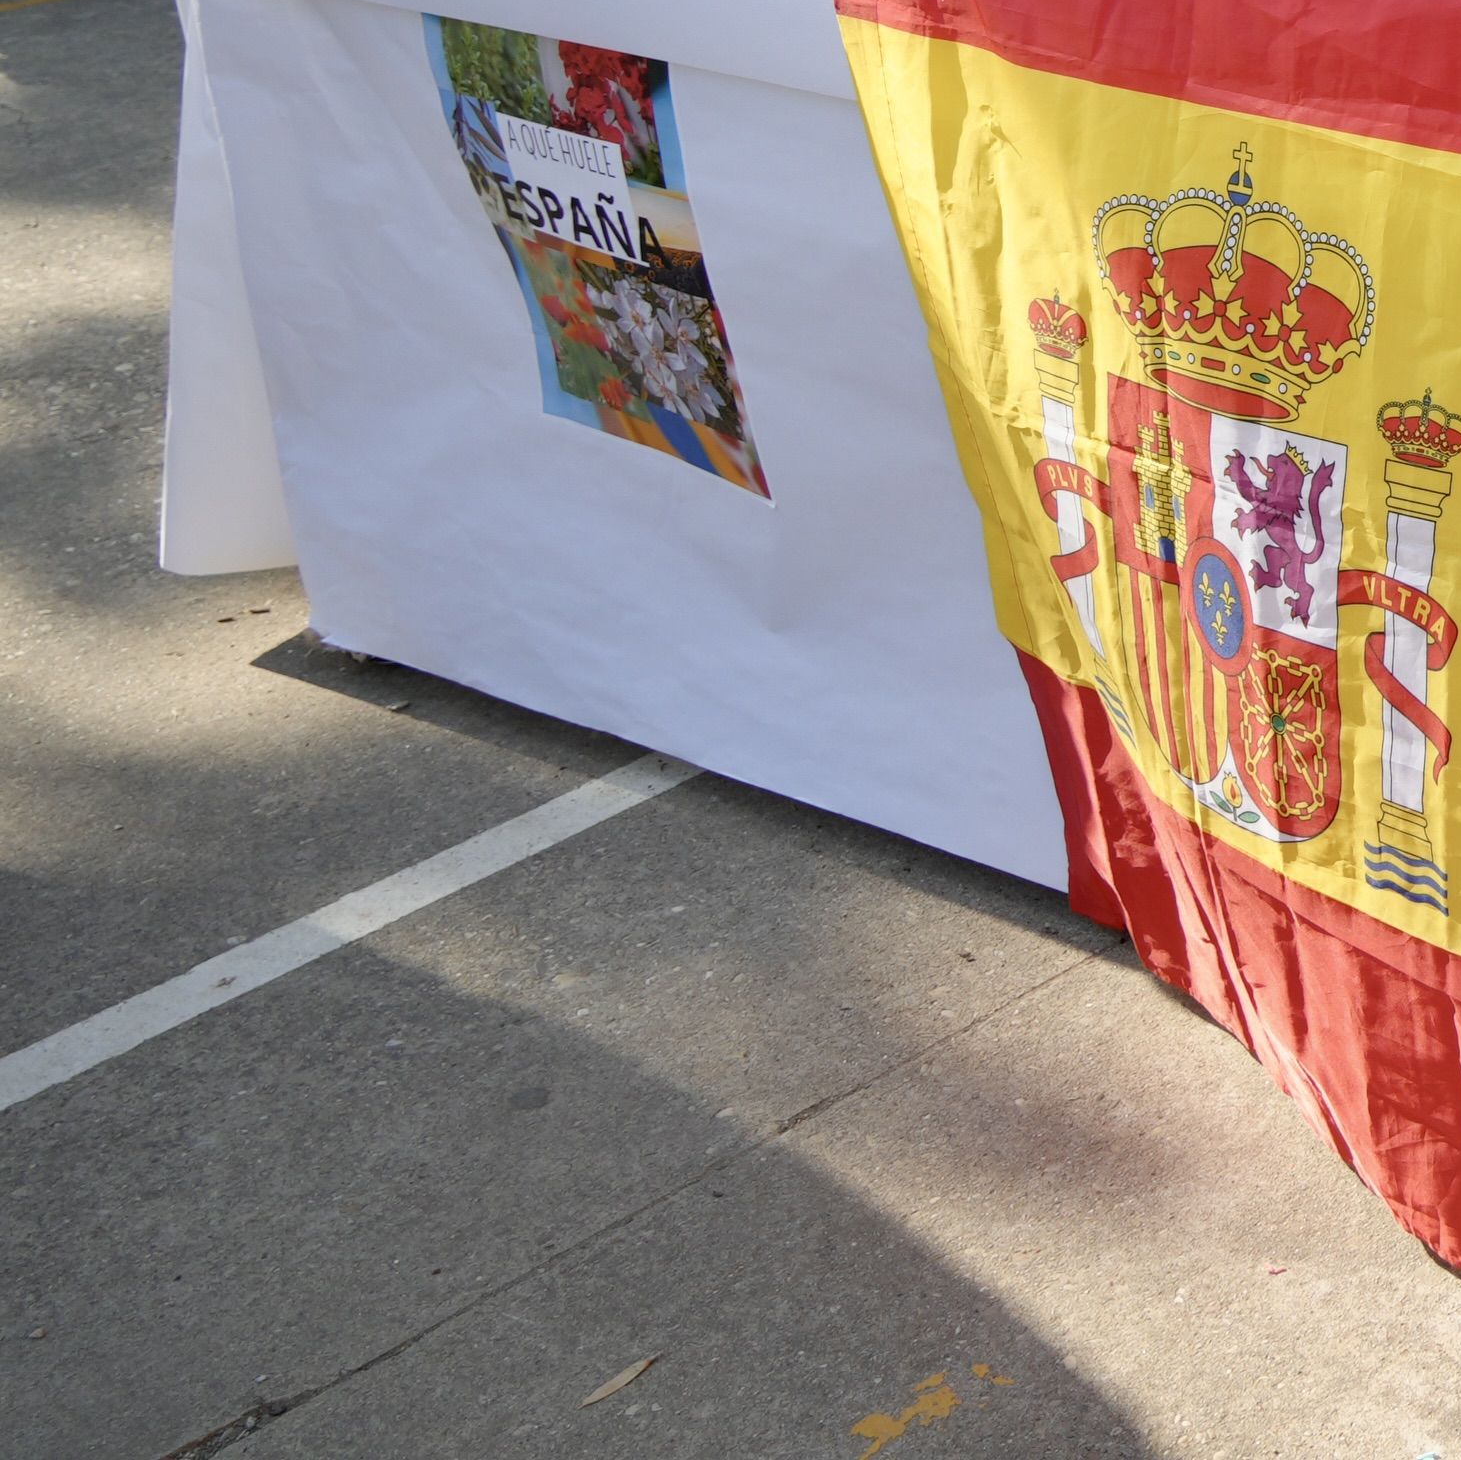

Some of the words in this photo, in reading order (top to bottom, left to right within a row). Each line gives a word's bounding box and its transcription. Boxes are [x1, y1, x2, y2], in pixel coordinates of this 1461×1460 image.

[507, 120, 521, 153] A
[521, 123, 560, 162] QUÉ
[558, 133, 616, 178] HUELE
[492, 171, 671, 270] ESPAÑA
[1046, 464, 1093, 498] PLVS
[1362, 575, 1446, 643] VLTRA
